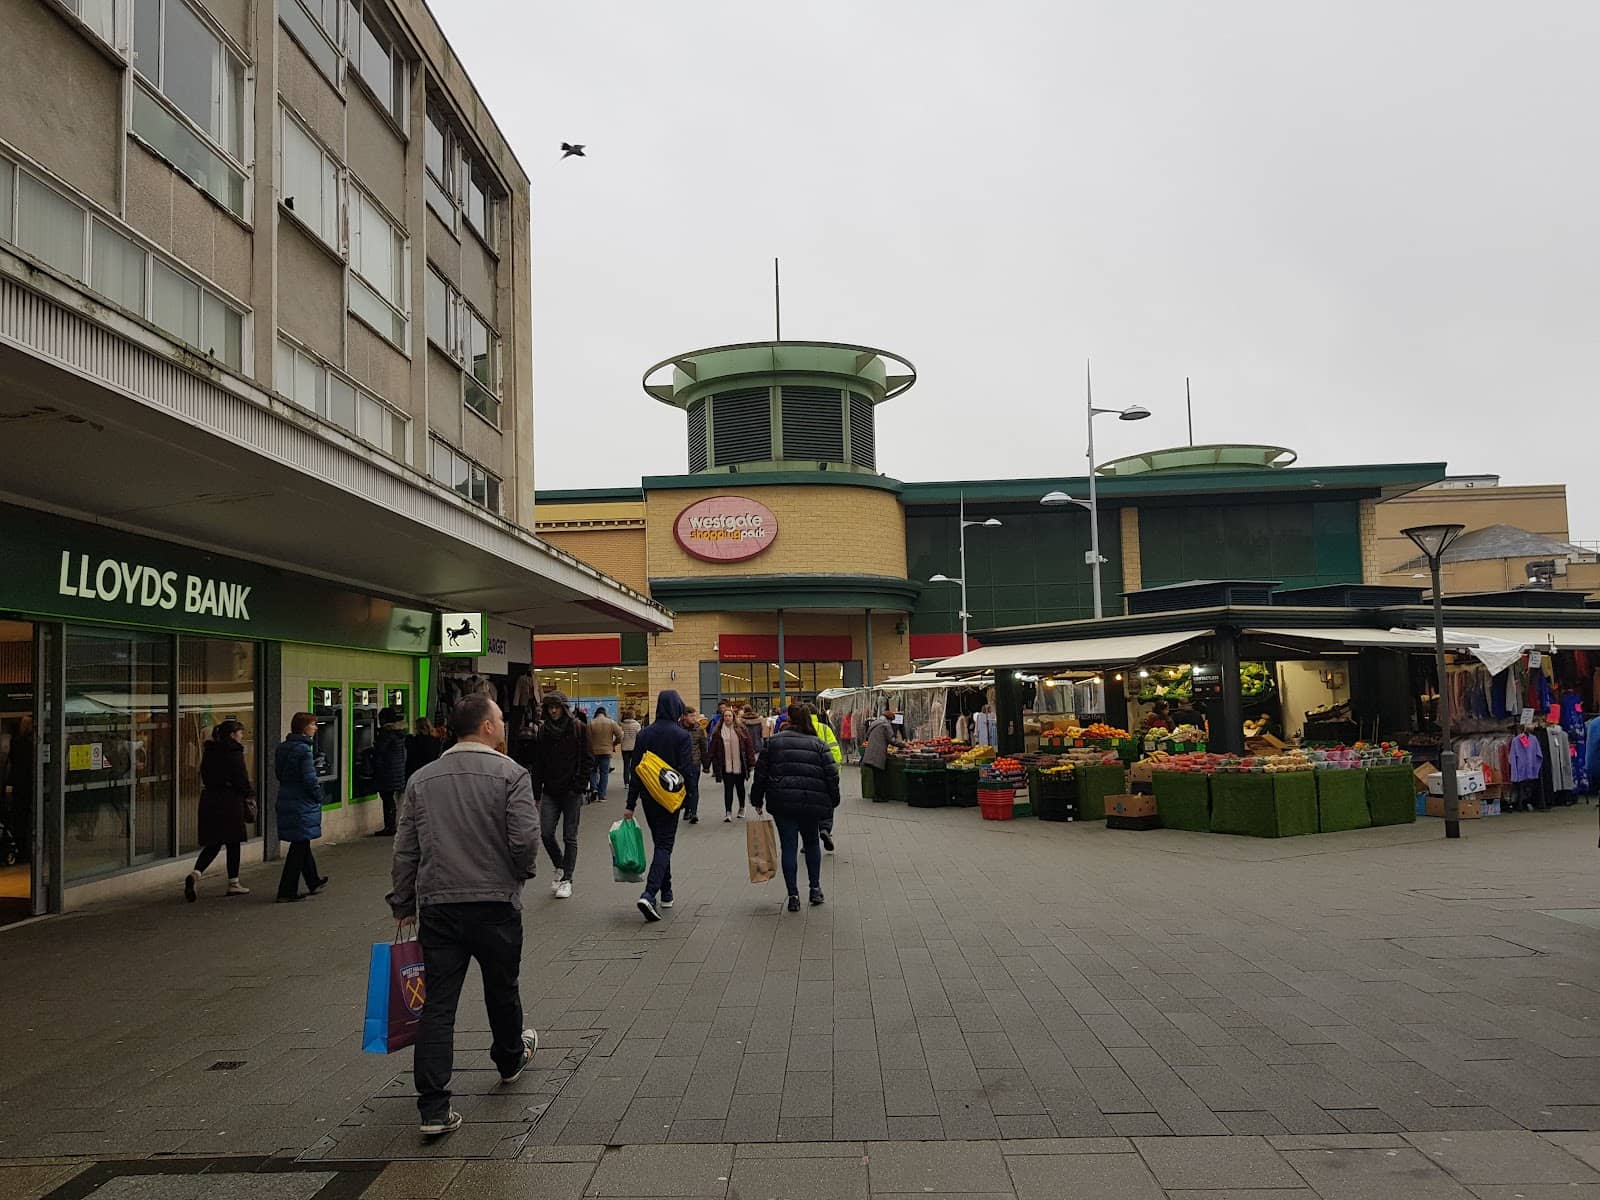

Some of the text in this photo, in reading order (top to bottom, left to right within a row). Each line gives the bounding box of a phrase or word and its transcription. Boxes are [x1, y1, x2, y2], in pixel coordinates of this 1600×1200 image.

[689, 512, 763, 532] westgate
[59, 550, 251, 620] LLOYDS BANK
[487, 637, 507, 656] ARGET
